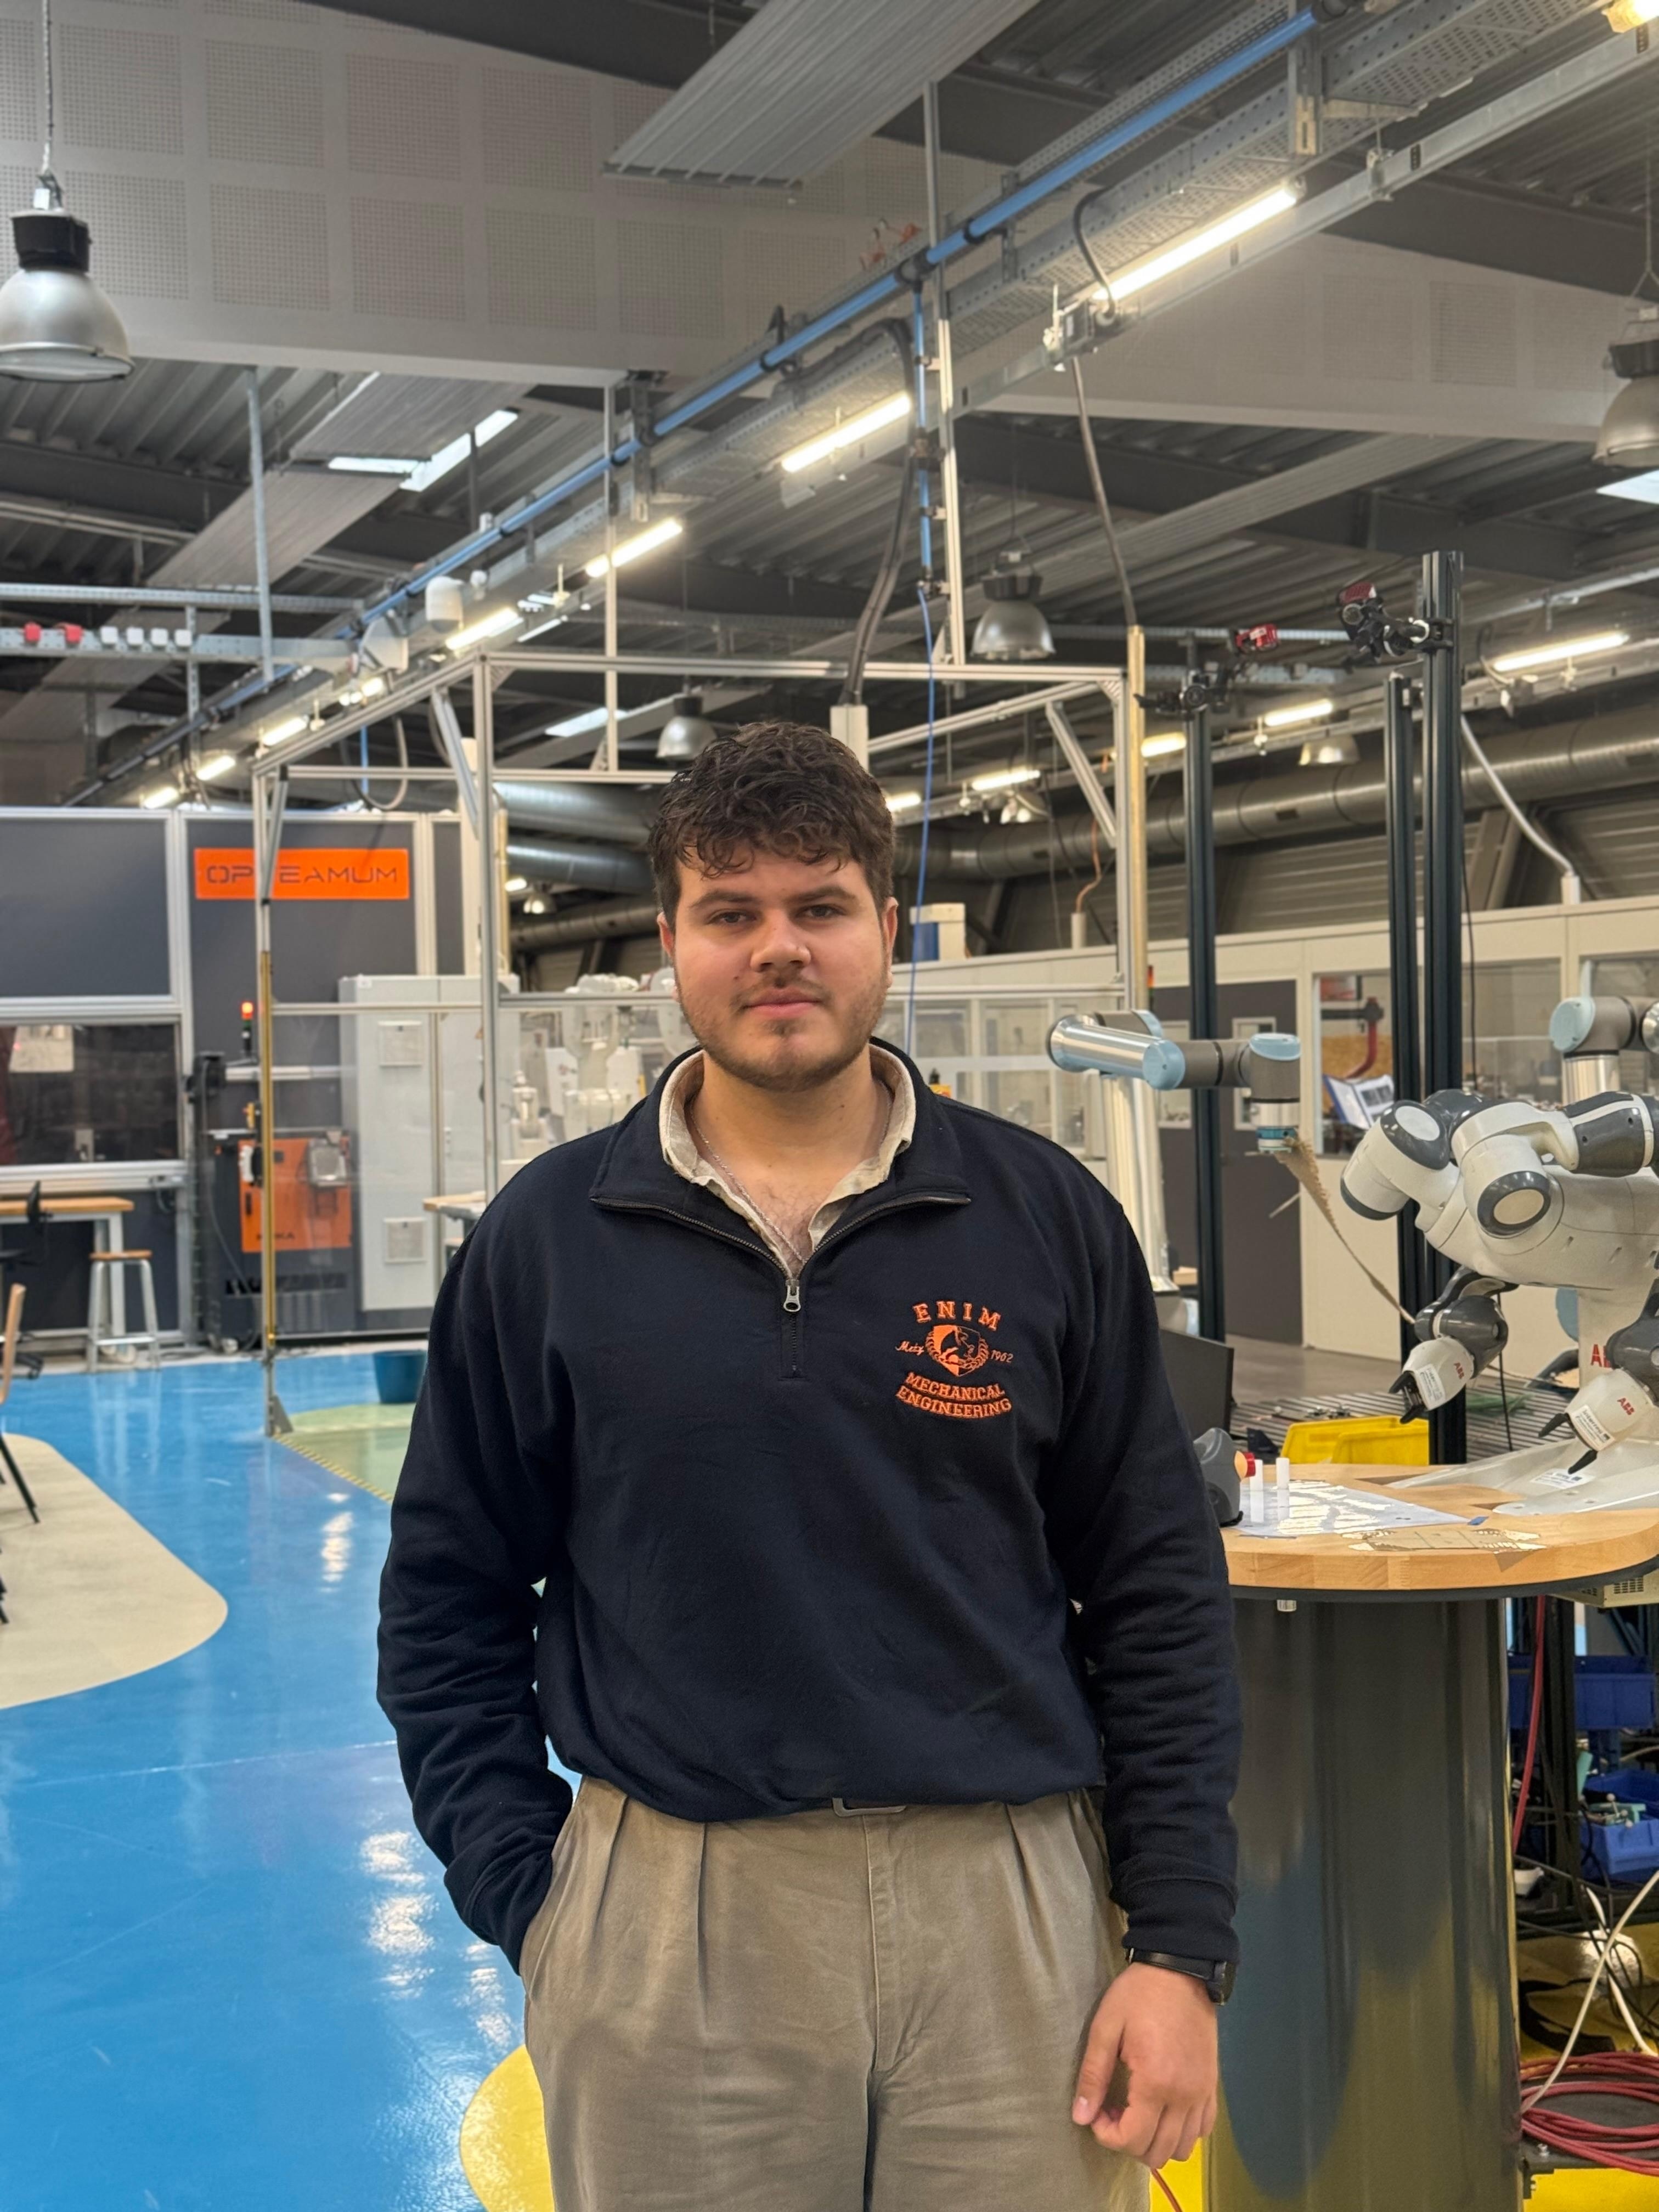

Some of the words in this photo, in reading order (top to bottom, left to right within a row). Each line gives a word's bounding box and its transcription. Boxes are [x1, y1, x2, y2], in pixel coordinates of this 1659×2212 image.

[206, 865, 397, 884] OPEAMUM
[913, 1300, 1001, 1330] ENIM
[990, 1349, 1013, 1363] 1962
[905, 1372, 1006, 1401] MECHANICAL
[895, 1385, 1013, 1419] ENGINEERING
[1616, 1397, 1635, 1416] ABB
